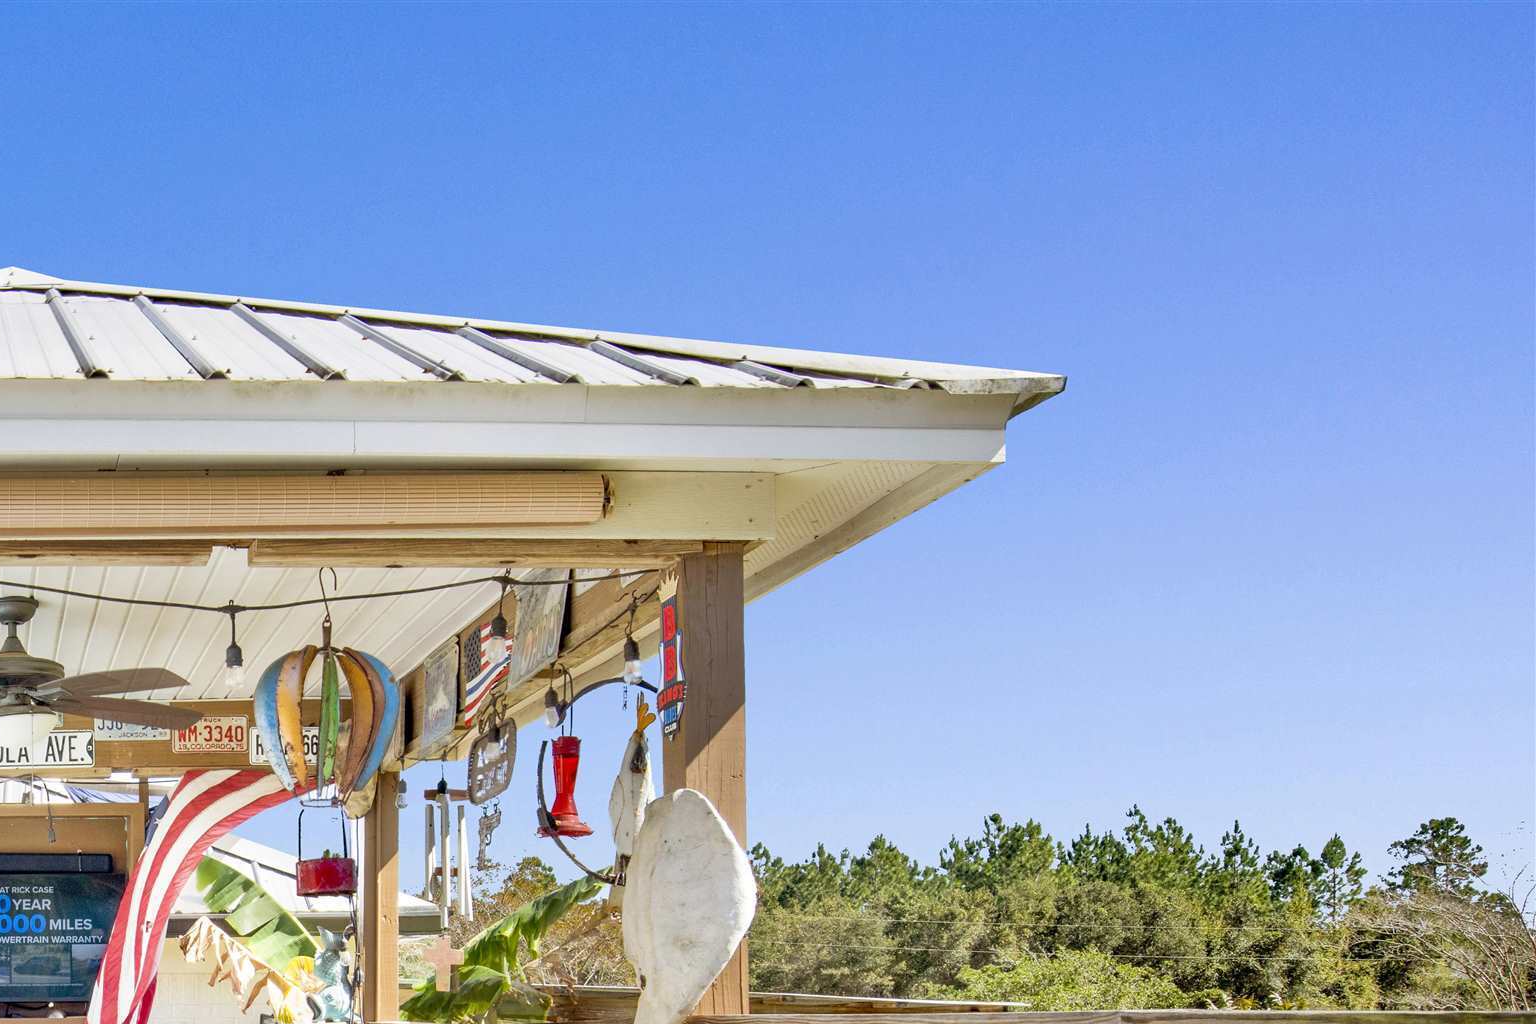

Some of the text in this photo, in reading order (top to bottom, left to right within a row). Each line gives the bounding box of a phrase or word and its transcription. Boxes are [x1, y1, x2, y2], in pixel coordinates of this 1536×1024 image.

[45, 735, 85, 763] AVE.
[0, 886, 10, 894] AT
[11, 886, 31, 894] RICK
[32, 886, 54, 894] CASE
[12, 898, 52, 911] YEAR
[49, 918, 93, 931] MILES
[50, 935, 103, 944] WARRANTY
